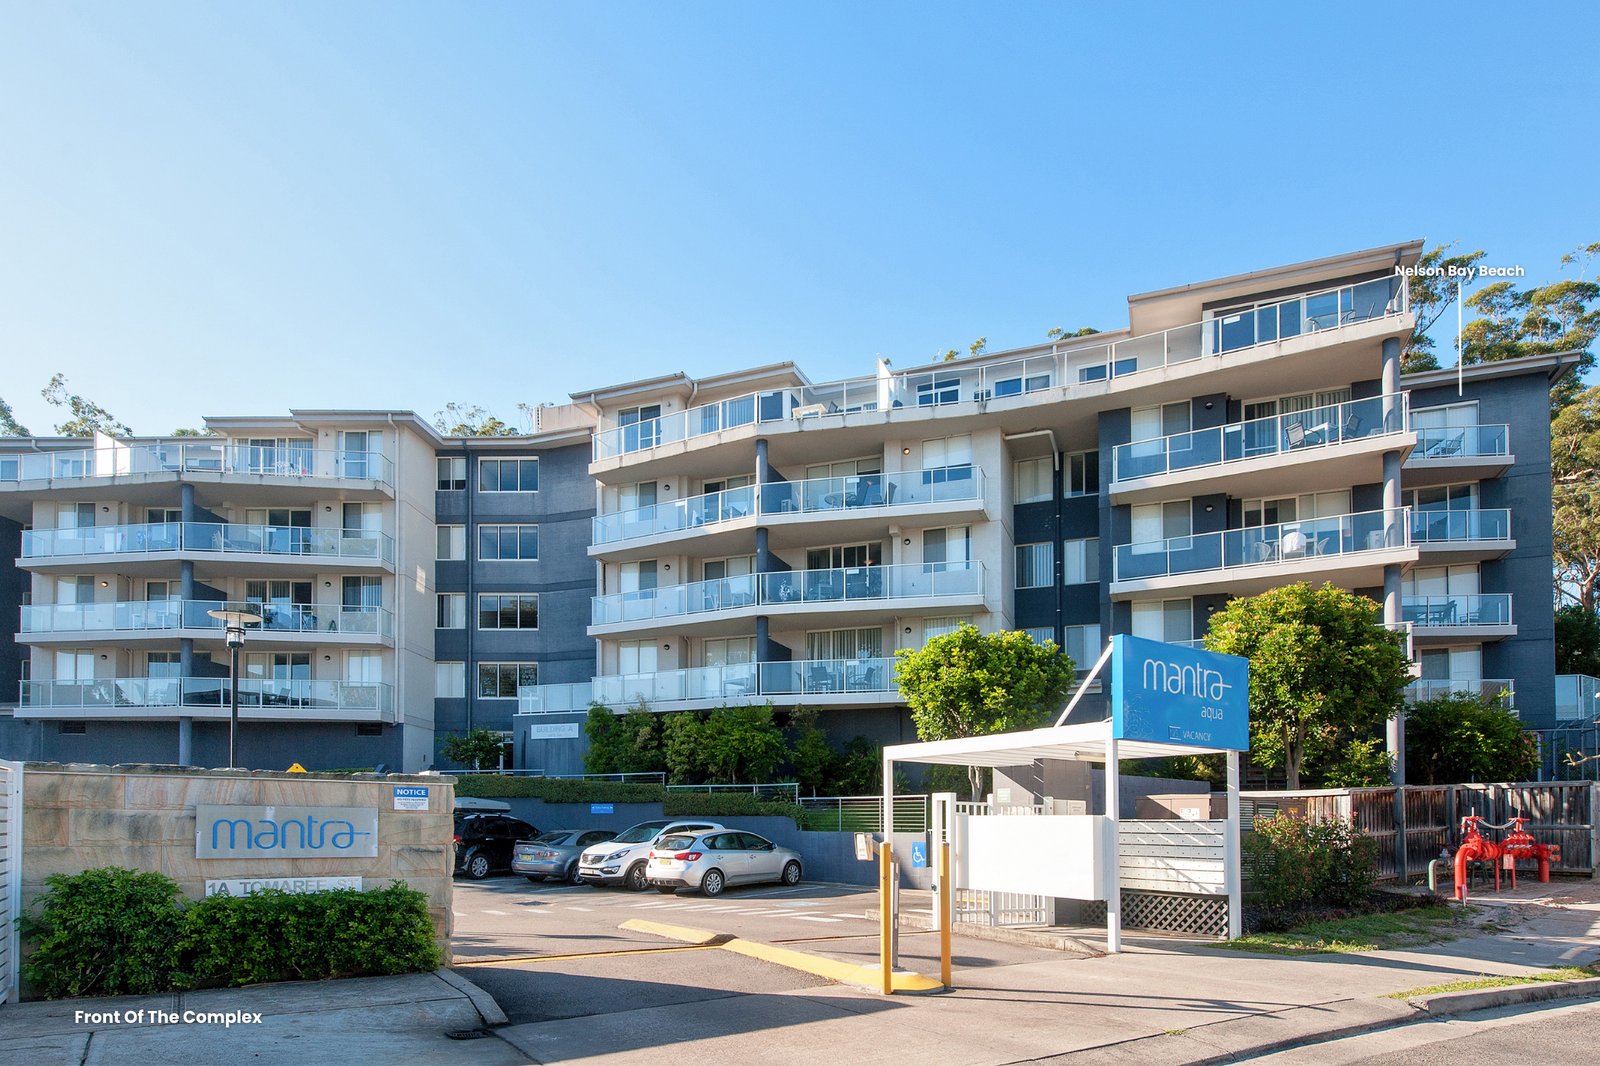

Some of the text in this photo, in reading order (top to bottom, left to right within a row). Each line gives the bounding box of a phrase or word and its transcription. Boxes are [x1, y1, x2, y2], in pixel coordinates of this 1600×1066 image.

[1143, 658, 1233, 701] mantra
[1200, 705, 1223, 722] aqua
[1182, 729, 1212, 742] VACANCY
[396, 788, 426, 796] NOTICE
[211, 814, 372, 850] mantra
[208, 881, 231, 896] 1A
[239, 879, 327, 895] TOMAREE
